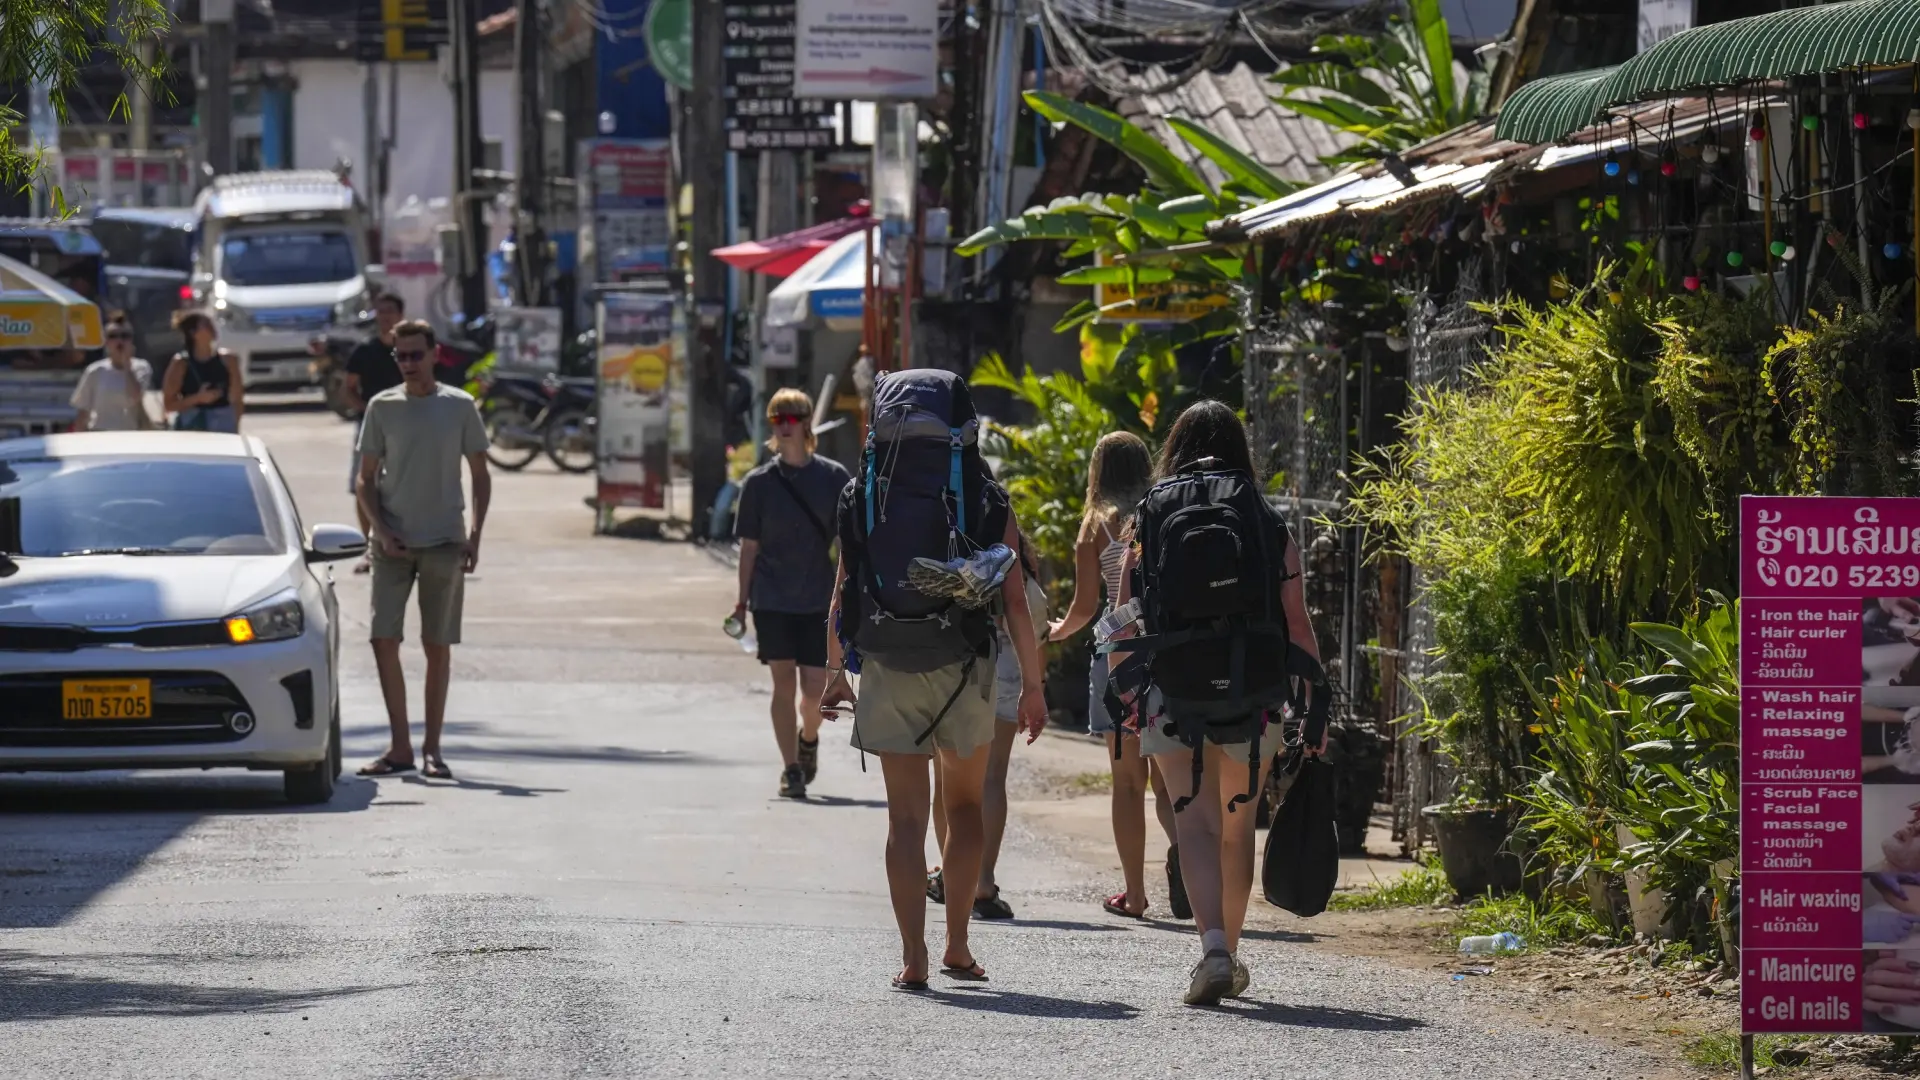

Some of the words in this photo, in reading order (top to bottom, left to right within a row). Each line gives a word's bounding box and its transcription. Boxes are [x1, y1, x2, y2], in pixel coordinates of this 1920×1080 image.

[1785, 565, 1838, 587] 020
[1848, 565, 1920, 587] 5239
[1761, 609, 1792, 621] Iron
[1797, 609, 1823, 621] the
[1828, 609, 1860, 621] hair
[1761, 626, 1794, 638] Hair
[1799, 626, 1847, 638] curler
[1762, 691, 1812, 703] Wash
[1819, 691, 1856, 703] hair
[100, 697, 147, 716] 5705
[1763, 708, 1845, 722] Relaxing
[1763, 727, 1847, 740] massage
[1763, 788, 1812, 798] Scrub
[1818, 788, 1858, 798] Face
[1763, 803, 1820, 814] Facial
[1763, 820, 1848, 832] massage
[1760, 889, 1796, 908] Hair
[1800, 889, 1861, 912] waxing
[1761, 957, 1856, 982] Manicure
[1761, 995, 1795, 1020] Gel
[1802, 995, 1851, 1020] nails
